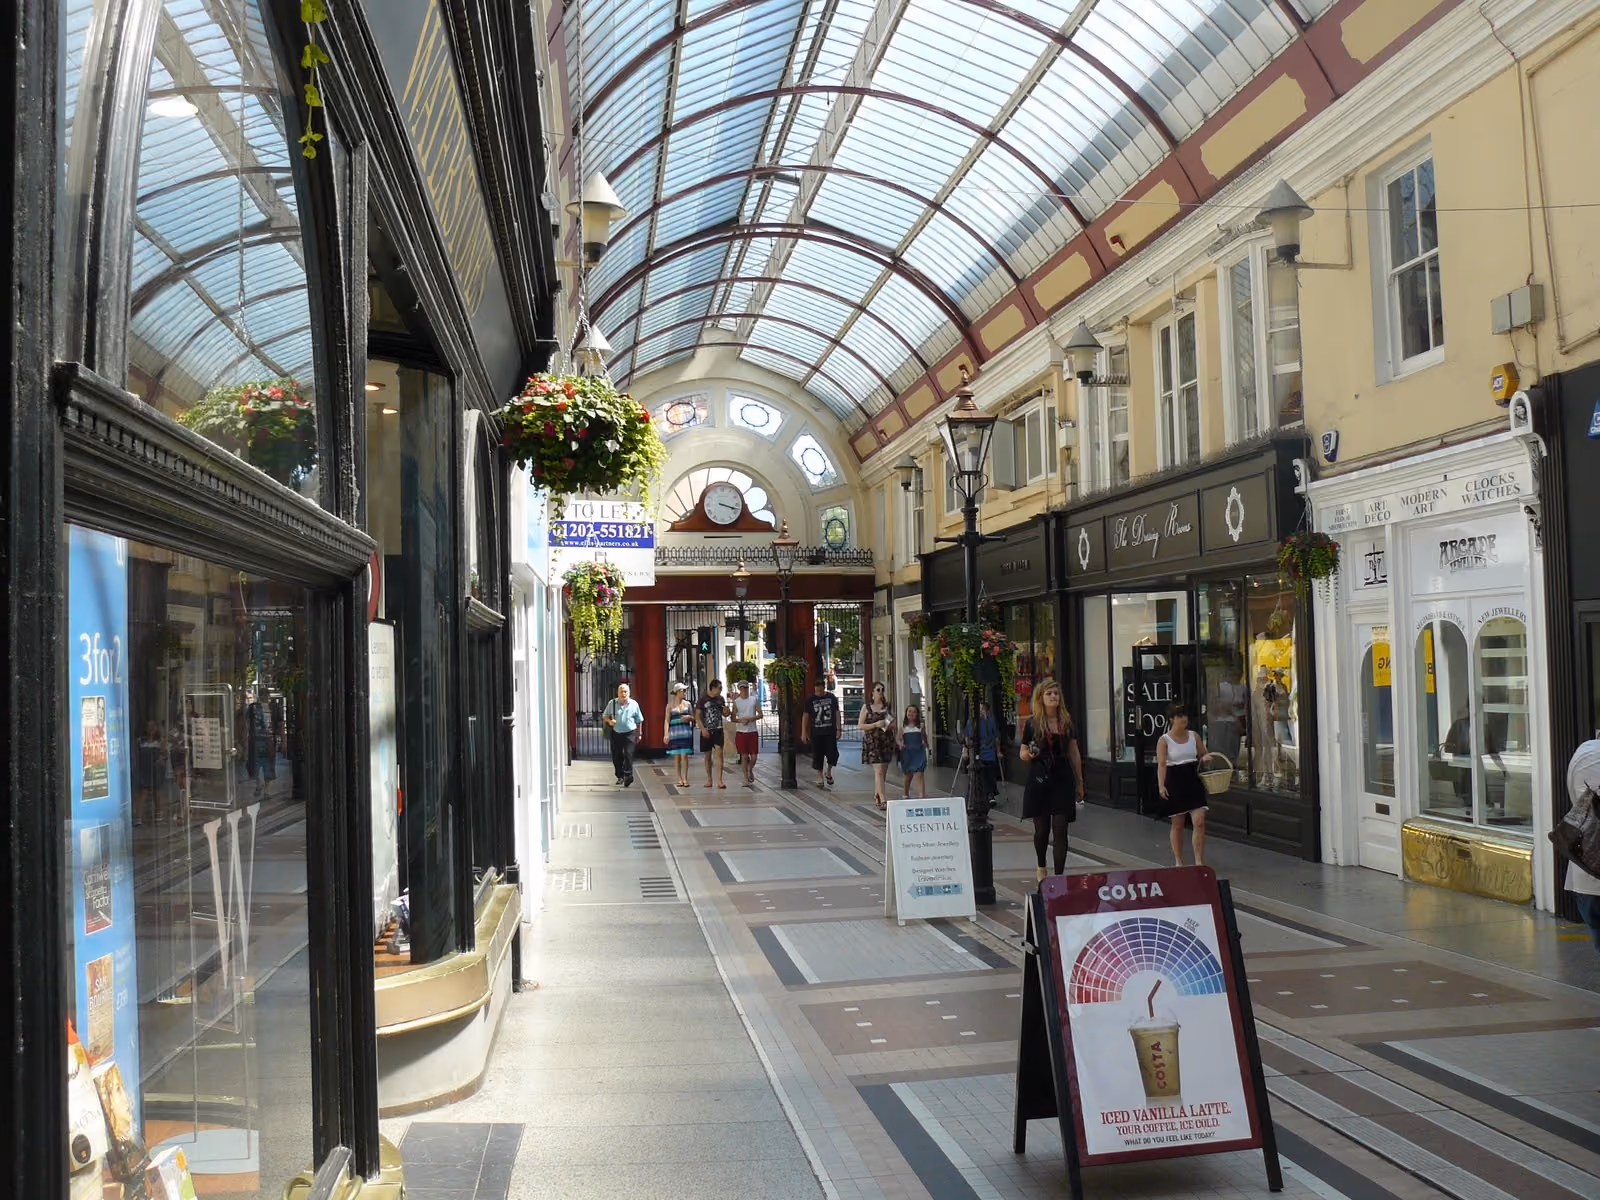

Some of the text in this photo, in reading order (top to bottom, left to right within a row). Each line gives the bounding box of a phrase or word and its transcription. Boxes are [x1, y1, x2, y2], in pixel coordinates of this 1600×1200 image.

[1465, 471, 1515, 493] CLOCKS
[1401, 487, 1448, 506] MODERN
[1461, 483, 1520, 505] WATCHES
[571, 503, 594, 518] TO
[1368, 500, 1388, 513] ART
[1412, 501, 1434, 516] ART
[1364, 511, 1391, 524] DECO
[552, 522, 650, 539] 01202-551821
[1439, 534, 1498, 569] ARCADE
[900, 822, 960, 833] ESSENTIAL
[1098, 882, 1163, 901] COSTA
[1151, 1041, 1167, 1089] COSTA
[1101, 1102, 1232, 1124] ICED VANILLA LATTE.
[1116, 1125, 1142, 1135] YOUR
[1180, 1120, 1194, 1130] ICE
[1195, 1118, 1220, 1129] COLD.
[1124, 1138, 1141, 1146] WHAT
[1194, 1131, 1216, 1139] TODAY?
